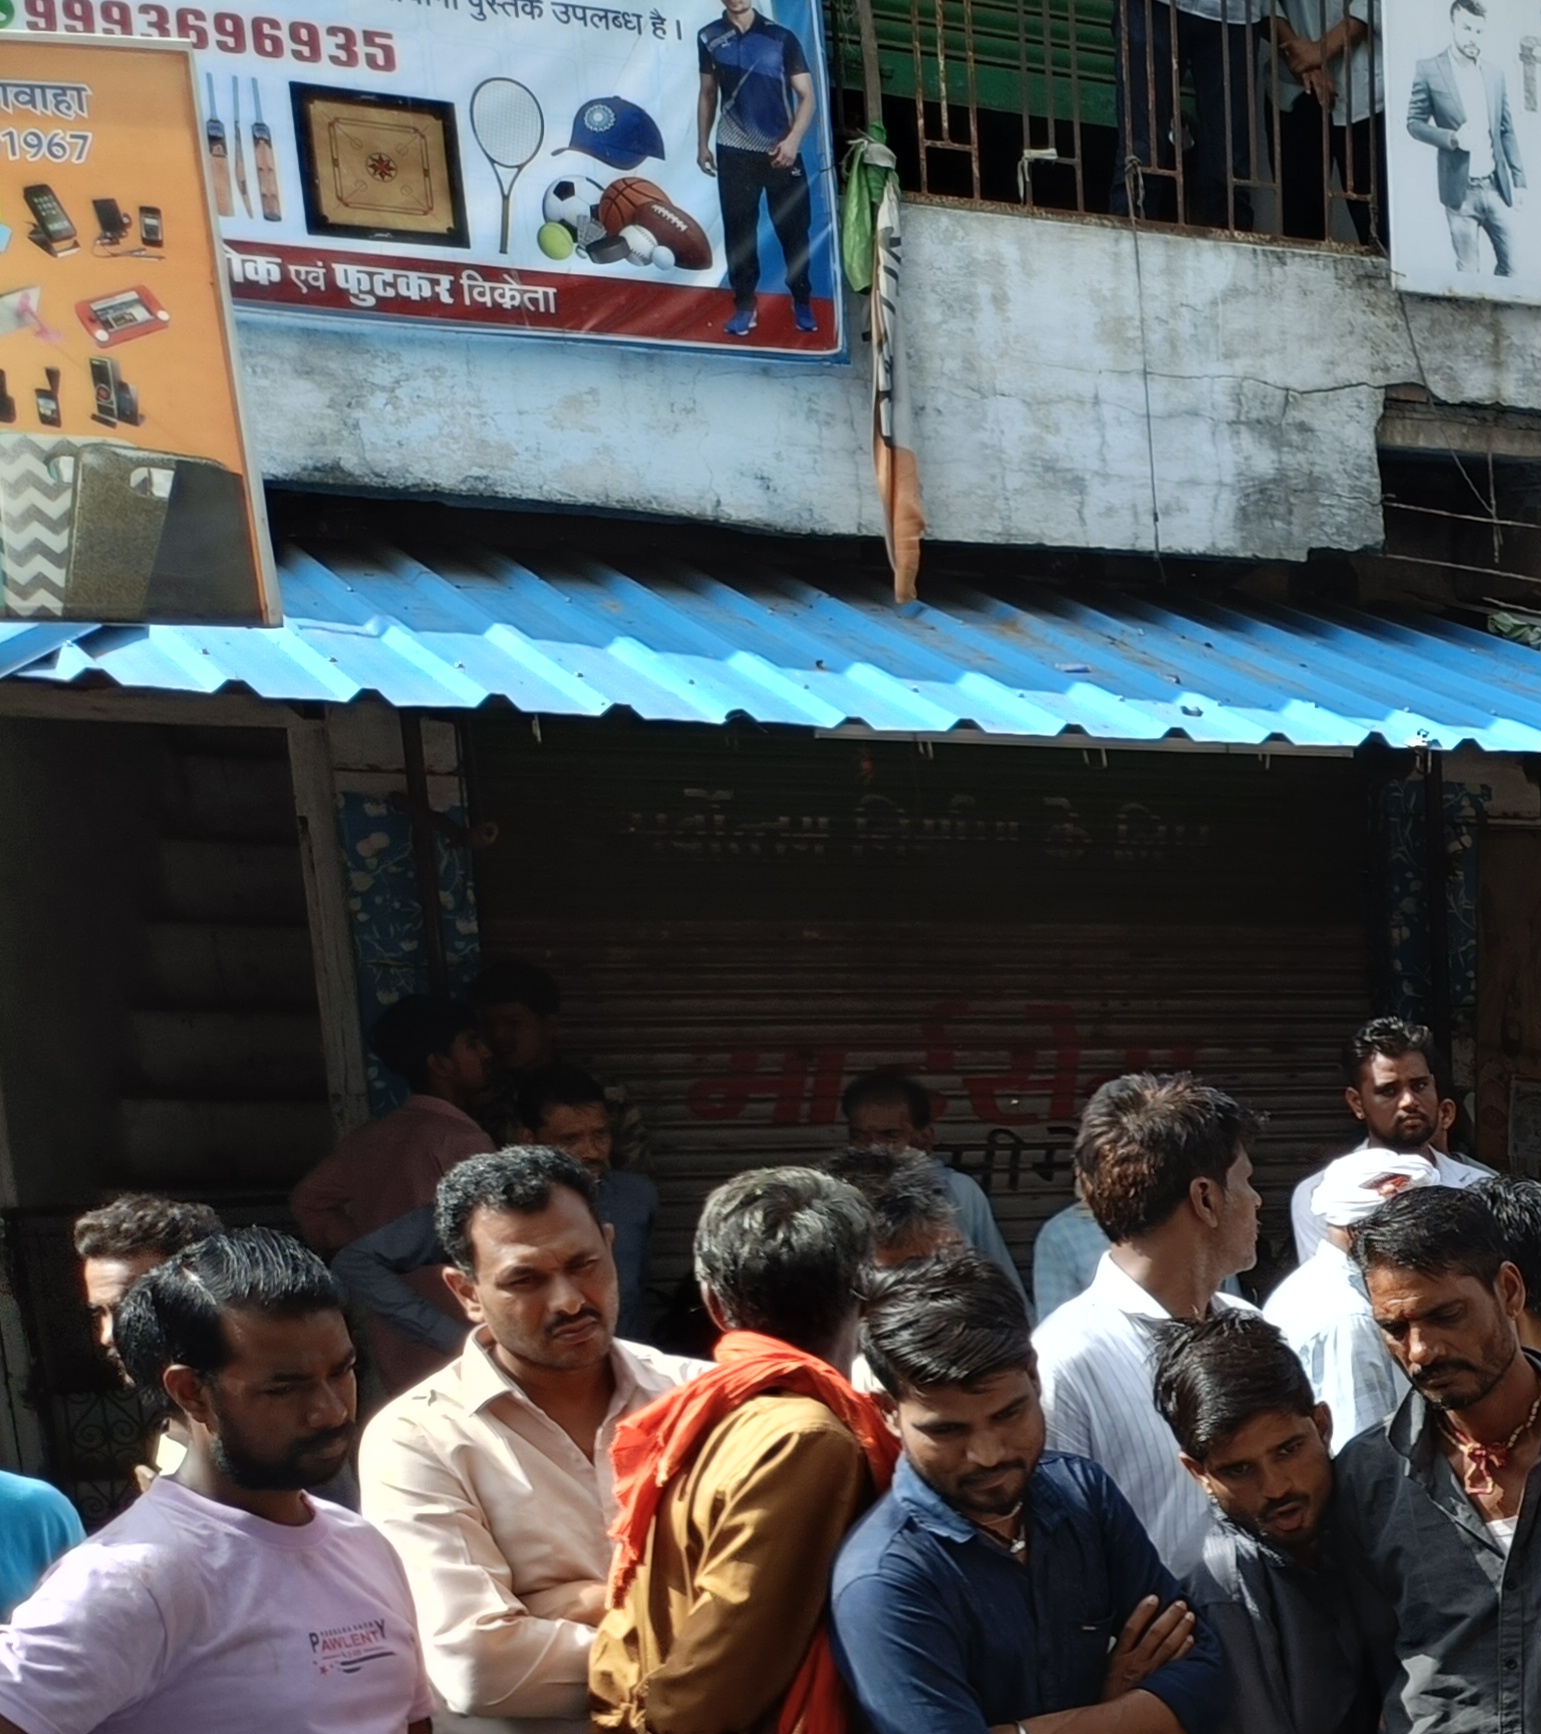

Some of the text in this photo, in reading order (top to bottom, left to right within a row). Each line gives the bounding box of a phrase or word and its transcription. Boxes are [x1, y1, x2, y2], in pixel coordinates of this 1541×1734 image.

[25, 0, 398, 73] 9993696935
[551, 0, 643, 37] उपलब्ध
[651, 10, 669, 40] है
[0, 80, 91, 120] वाहा
[1, 126, 93, 164] 1967
[226, 246, 558, 314] ोक एवं फुटकर विक्रेता
[308, 1618, 386, 1654] PAWLENTY
